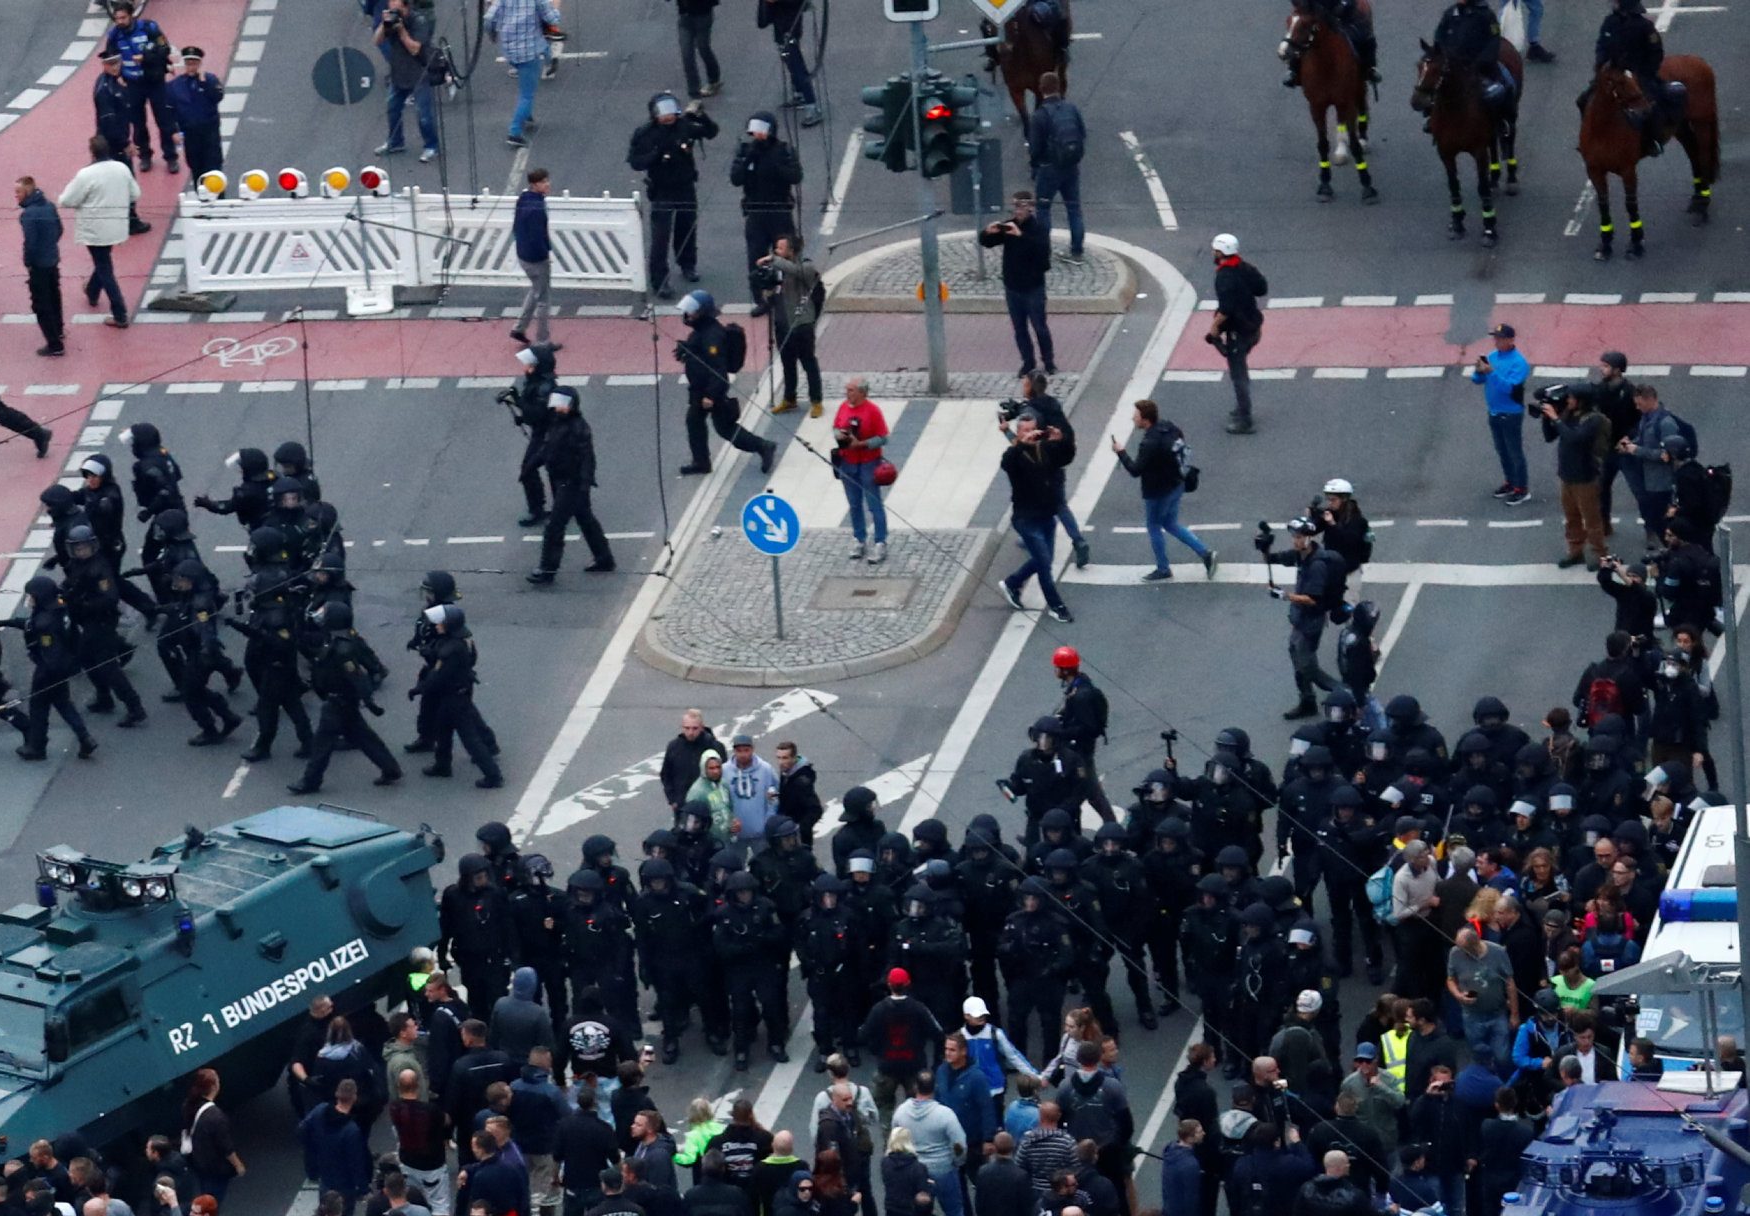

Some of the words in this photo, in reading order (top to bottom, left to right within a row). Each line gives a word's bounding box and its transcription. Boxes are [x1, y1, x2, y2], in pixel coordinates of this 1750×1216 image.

[169, 1022, 199, 1055] RZ
[202, 1013, 220, 1034] 1
[220, 938, 369, 1028] BUNDESPOLIZEI
